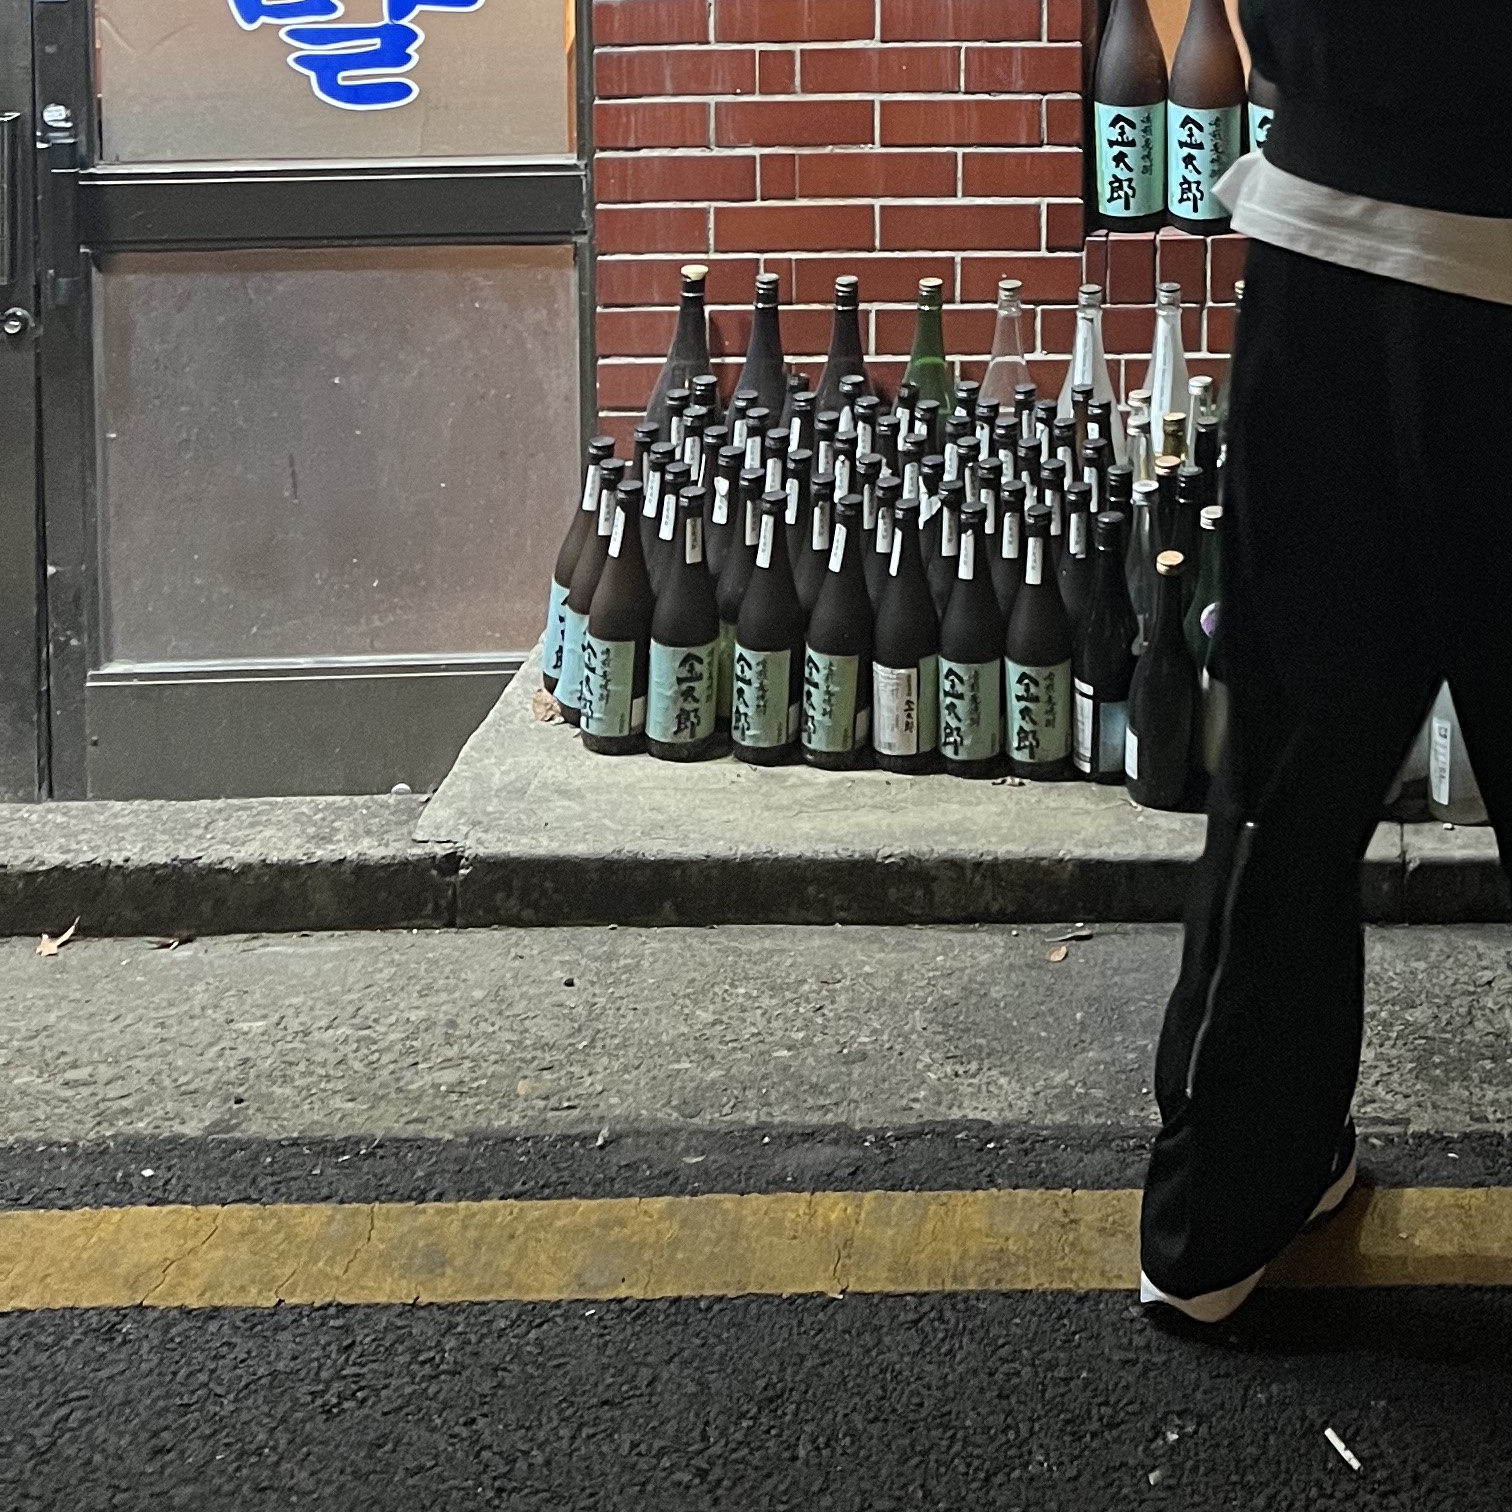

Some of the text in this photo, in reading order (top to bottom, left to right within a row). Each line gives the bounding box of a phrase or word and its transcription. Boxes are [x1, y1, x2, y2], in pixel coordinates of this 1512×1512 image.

[1107, 113, 1137, 211] 金太郎
[1178, 114, 1206, 214] 金太郎
[1014, 671, 1040, 760] 金太郎
